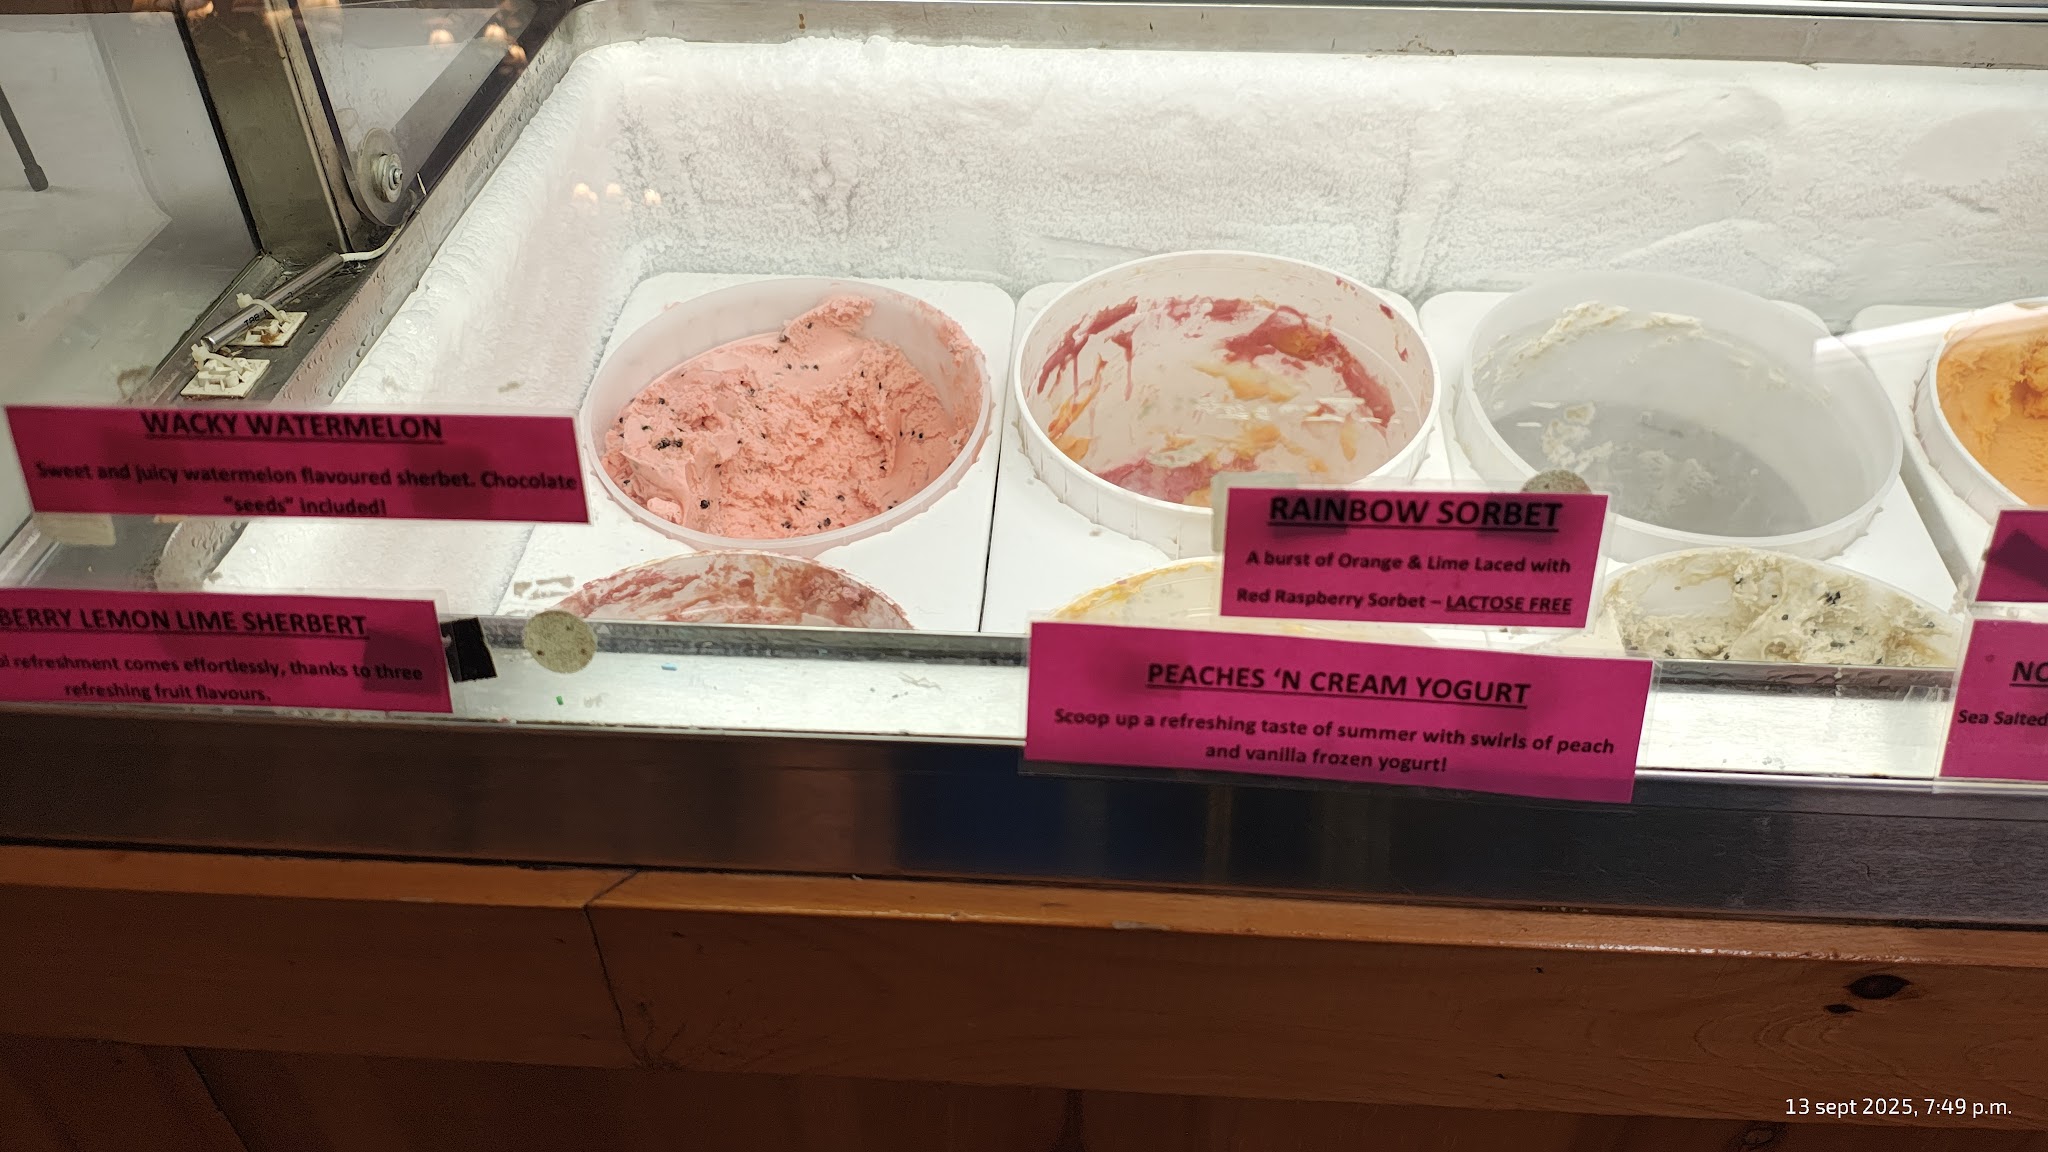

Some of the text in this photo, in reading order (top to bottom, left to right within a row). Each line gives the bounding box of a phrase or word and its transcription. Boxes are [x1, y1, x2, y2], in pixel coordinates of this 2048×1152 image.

[140, 411, 443, 439] WACKY WATERMELON
[35, 461, 577, 490] Sweet and juicy watermelon flavoured sherbet. Chocolate
[299, 497, 387, 516] included!
[1270, 497, 1563, 526] RAINBOW SORBET
[1246, 551, 1571, 573] A burst of Orange & Lime Laced with
[1237, 588, 1271, 603] Red
[1275, 589, 1363, 608] Raspberry
[1368, 592, 1426, 608] Sorbet
[1446, 595, 1524, 612] LACTOSE
[1529, 598, 1572, 612] FREE
[79, 609, 171, 629] LEMON
[176, 611, 238, 631] LIME
[242, 612, 367, 635] SHERBERT
[14, 655, 120, 671] refreshment
[124, 658, 179, 672] comes
[183, 657, 285, 677] effortlessly,
[289, 660, 348, 677] thanks
[353, 664, 371, 678] to
[375, 664, 423, 681] three
[65, 682, 271, 702] refreshing fruit flavours.
[1147, 663, 1265, 688] PEACHES
[1310, 671, 1407, 696] CREAM
[1416, 676, 1531, 704] YOGURT
[1957, 709, 1989, 725] Sea
[1054, 708, 1615, 754] Scoop up a refreshing taste of summer with swirls of peach
[1206, 744, 1448, 772] and vanilla frozen yogurt!
